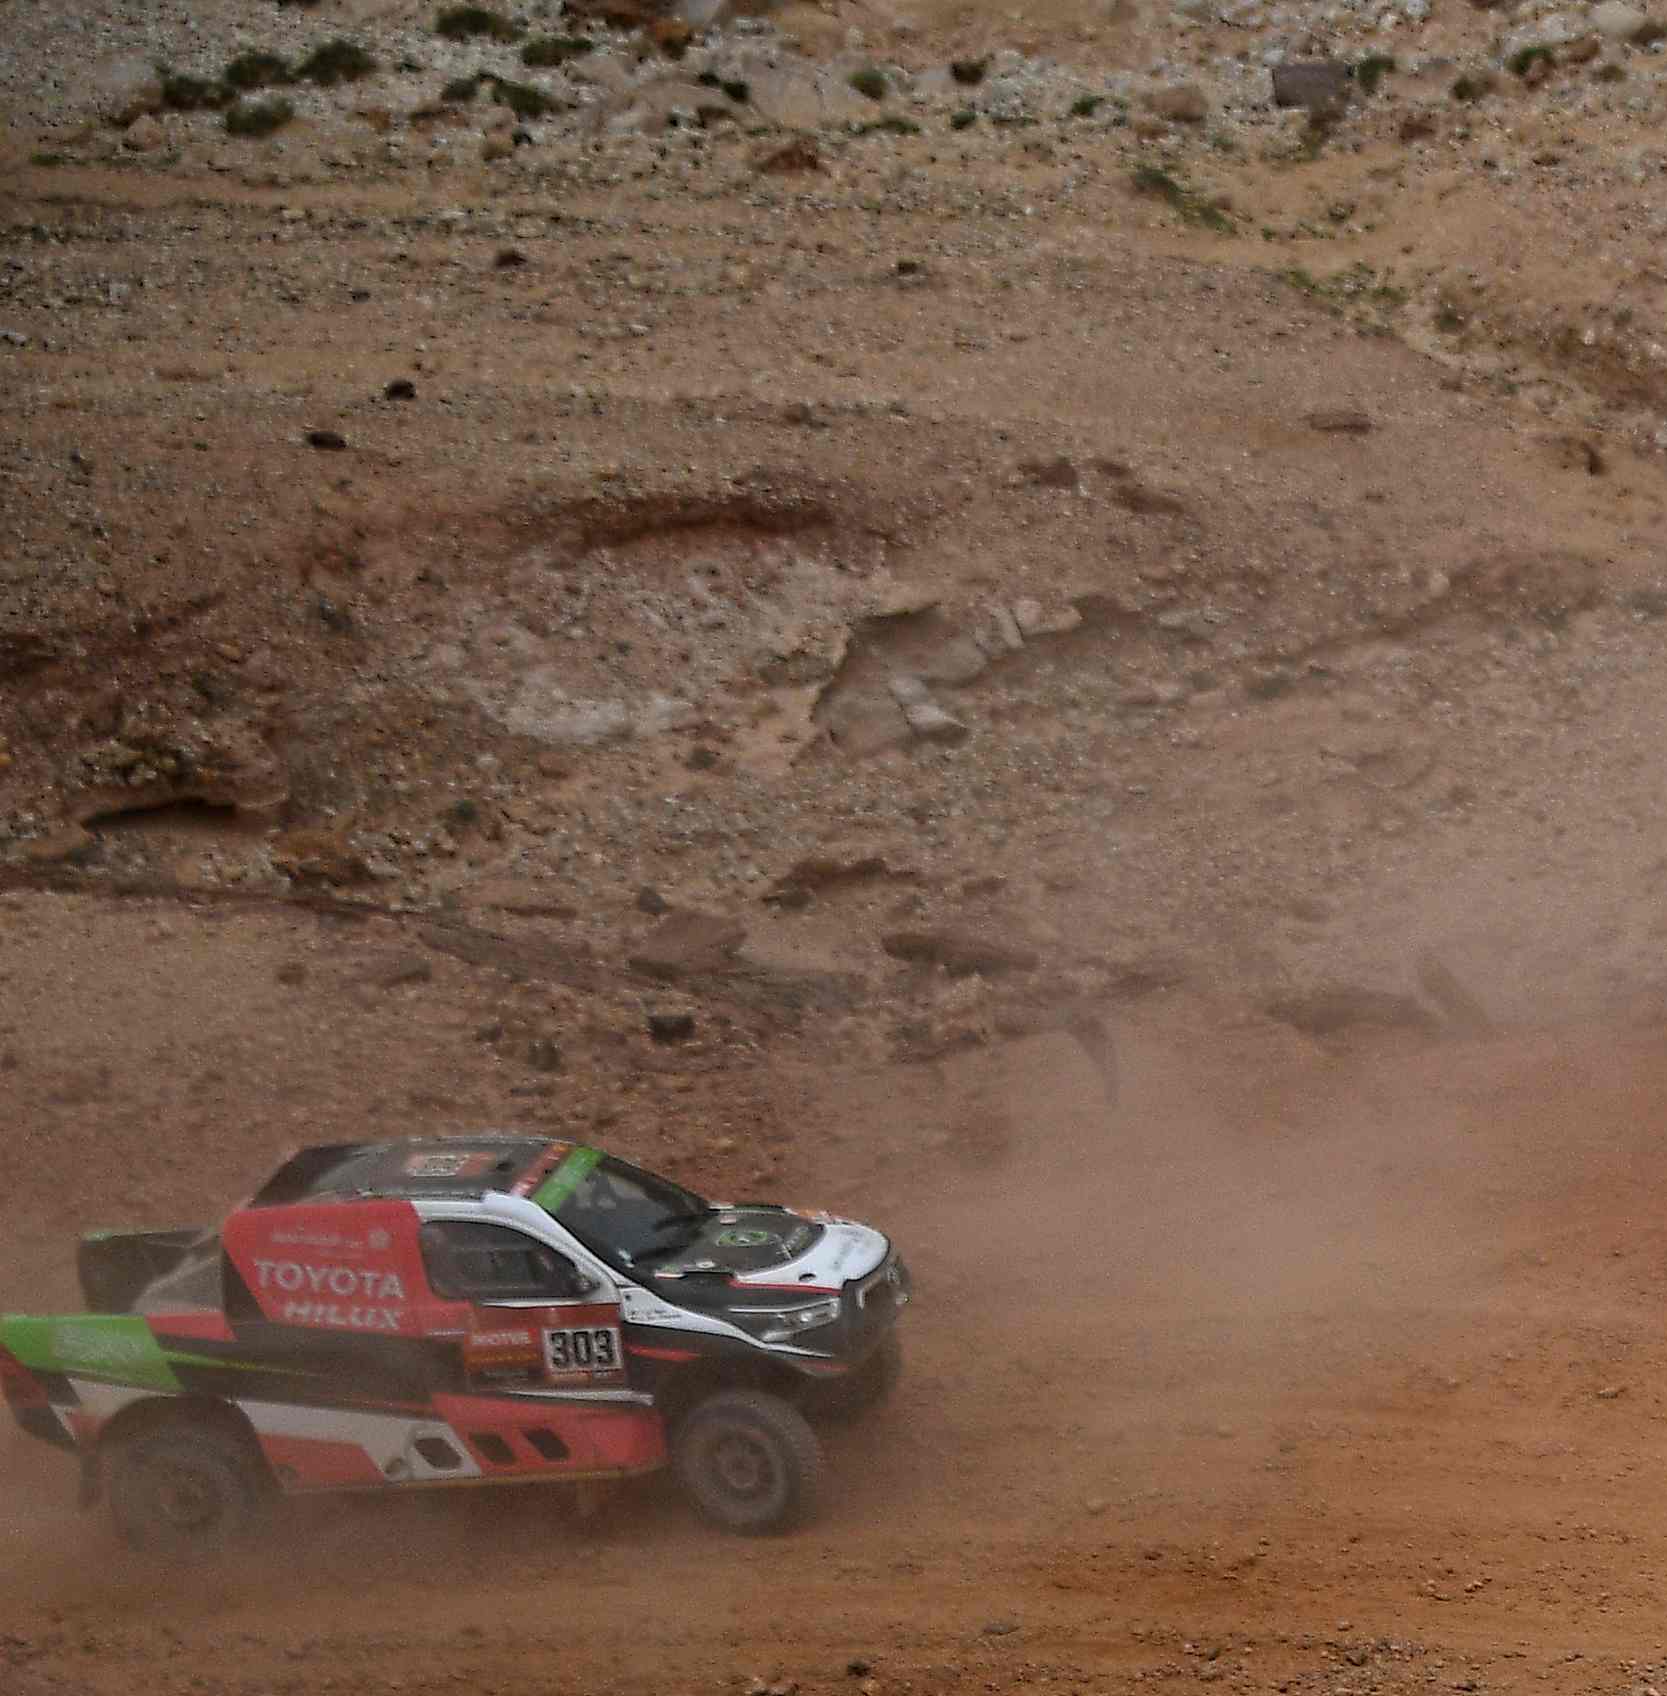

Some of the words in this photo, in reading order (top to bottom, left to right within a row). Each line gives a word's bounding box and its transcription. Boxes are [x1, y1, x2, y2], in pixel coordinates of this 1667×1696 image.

[253, 1258, 405, 1300] TOYOTA
[283, 1302, 402, 1331] HILUX
[551, 1329, 614, 1368] 303
